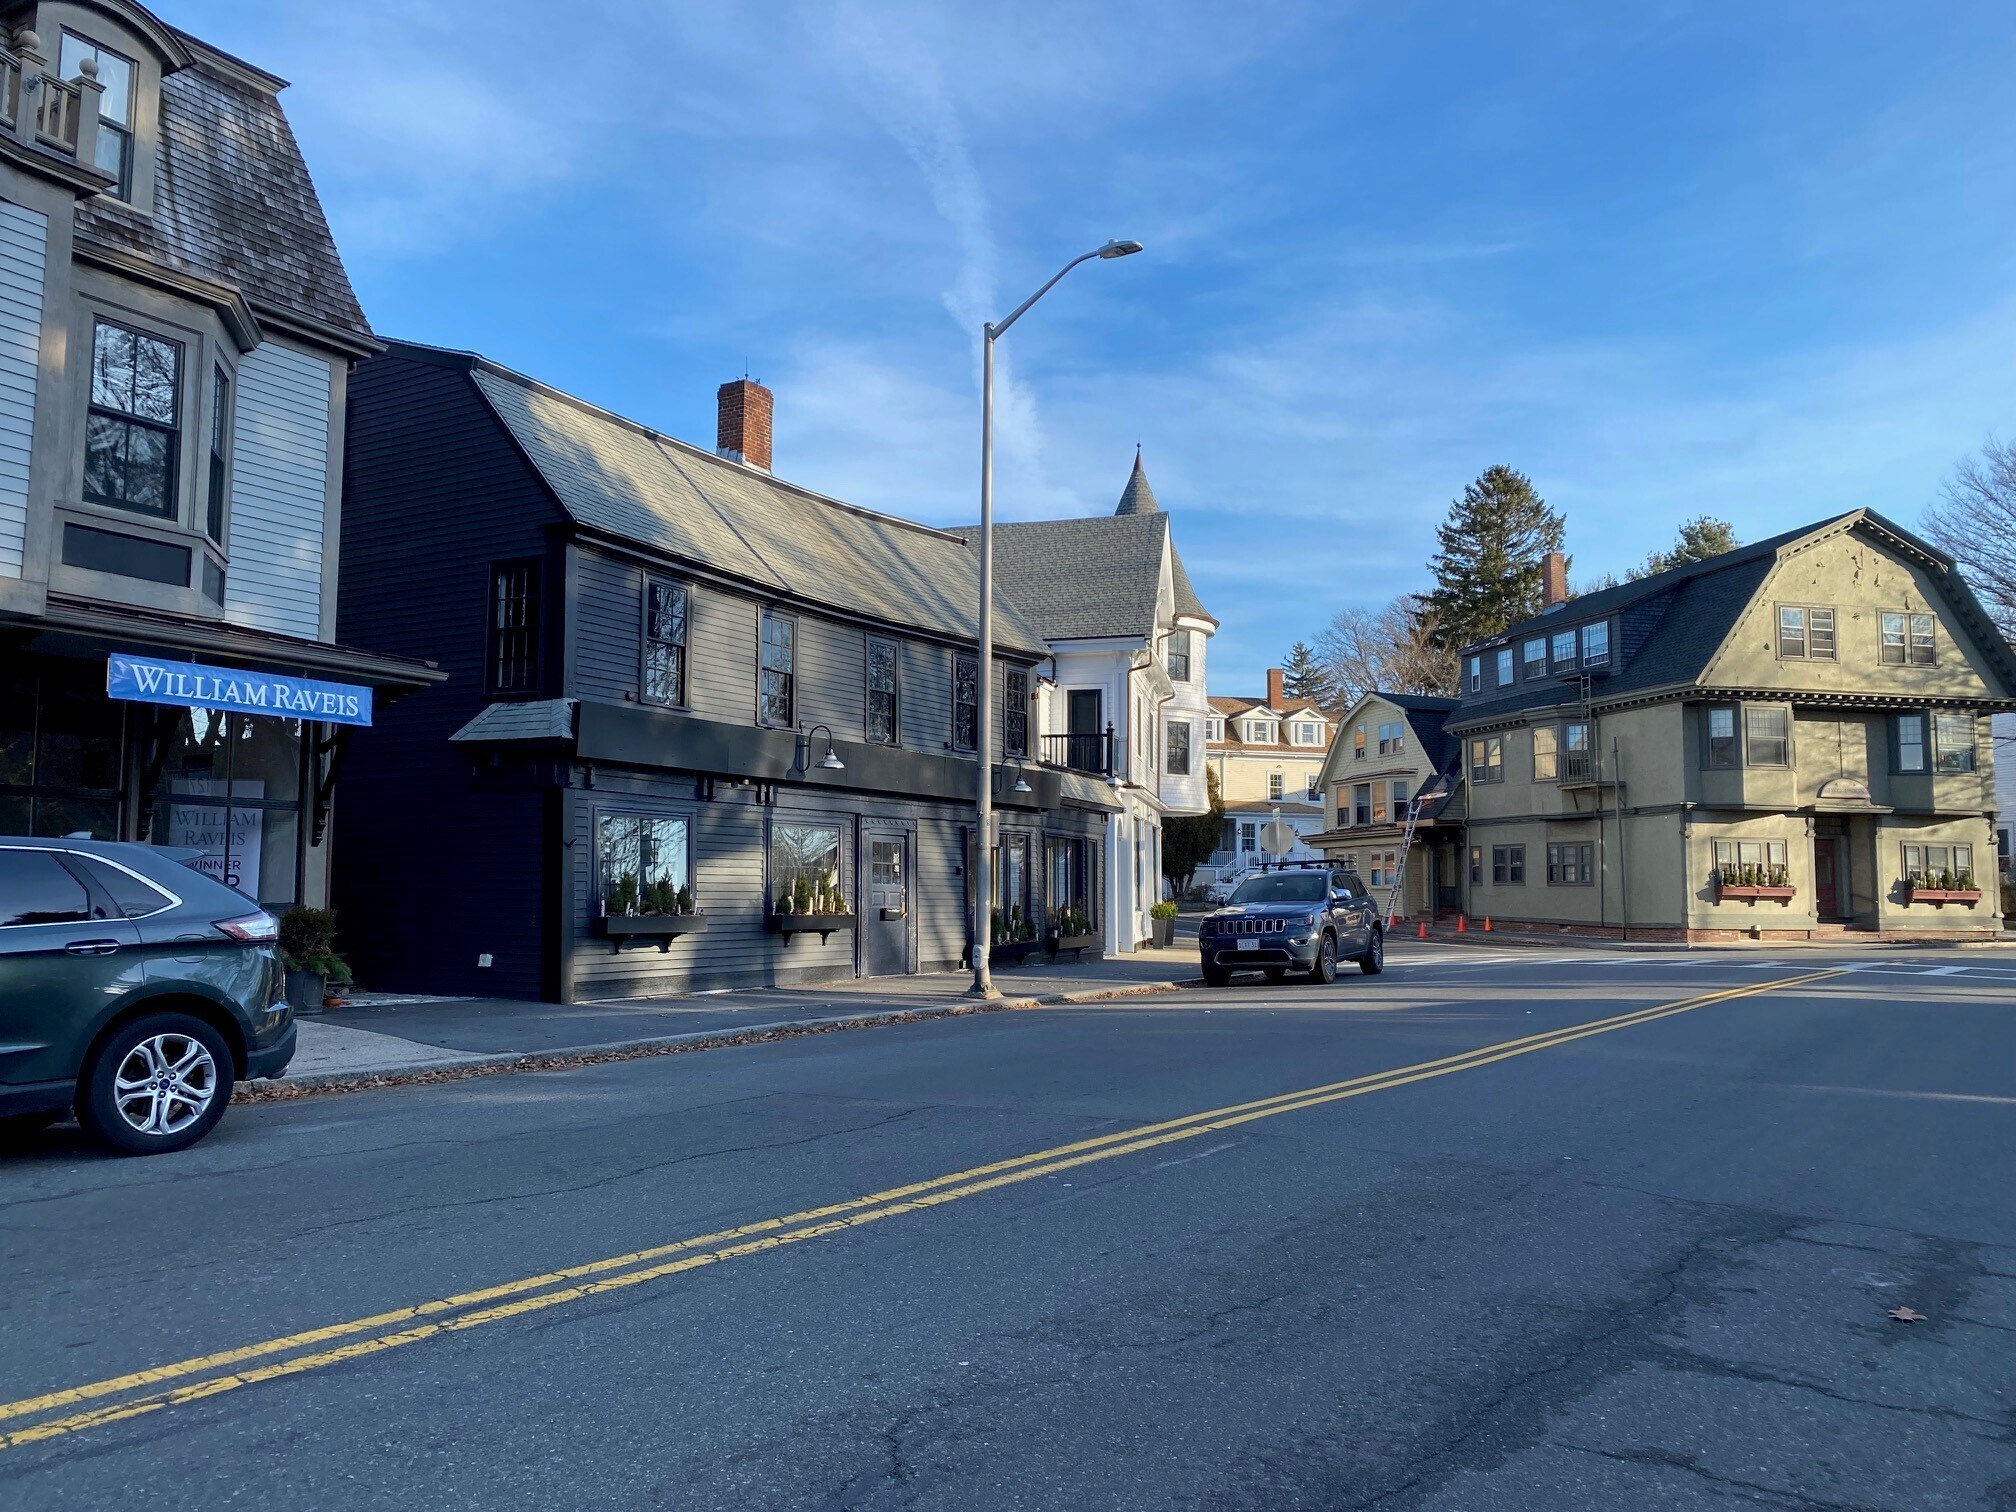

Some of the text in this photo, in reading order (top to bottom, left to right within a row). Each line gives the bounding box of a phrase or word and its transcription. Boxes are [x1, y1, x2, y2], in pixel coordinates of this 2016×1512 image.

[130, 664, 359, 717] WILLIAM RAVEIS
[176, 810, 257, 826] WILLIAM
